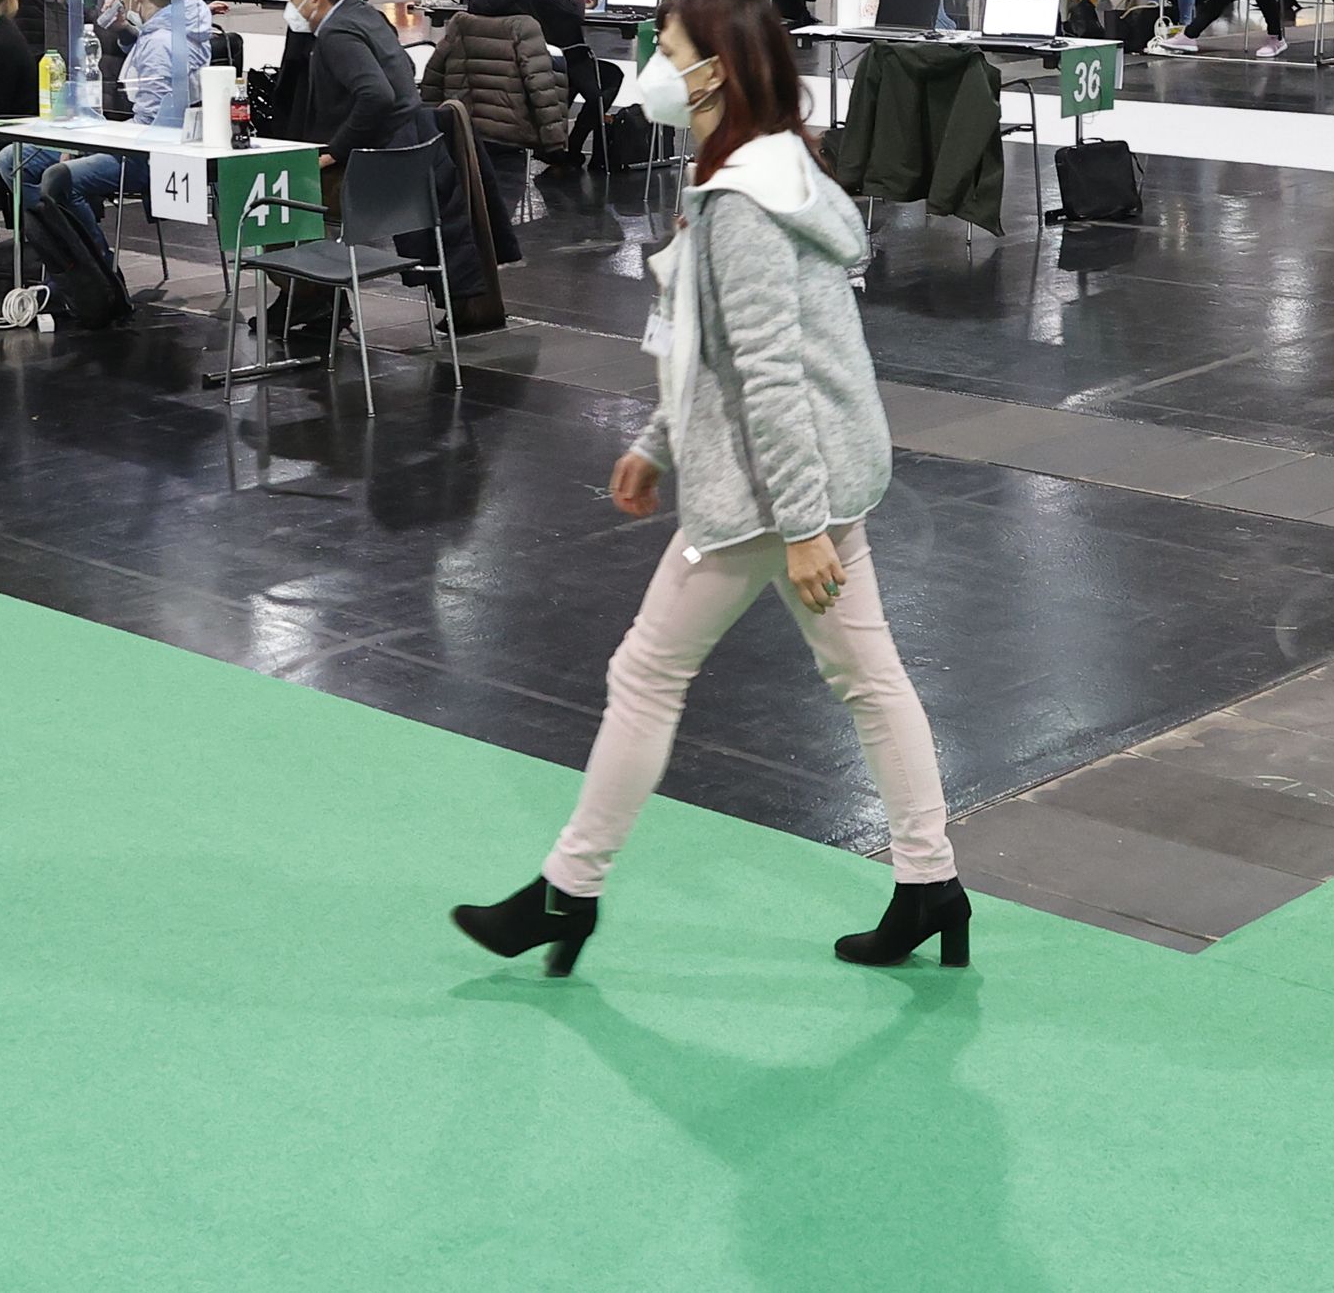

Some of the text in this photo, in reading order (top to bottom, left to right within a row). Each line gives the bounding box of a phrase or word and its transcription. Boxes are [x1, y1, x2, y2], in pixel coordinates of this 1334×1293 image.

[1073, 59, 1102, 103] 36
[165, 171, 190, 203] 41
[243, 170, 291, 227] 41
